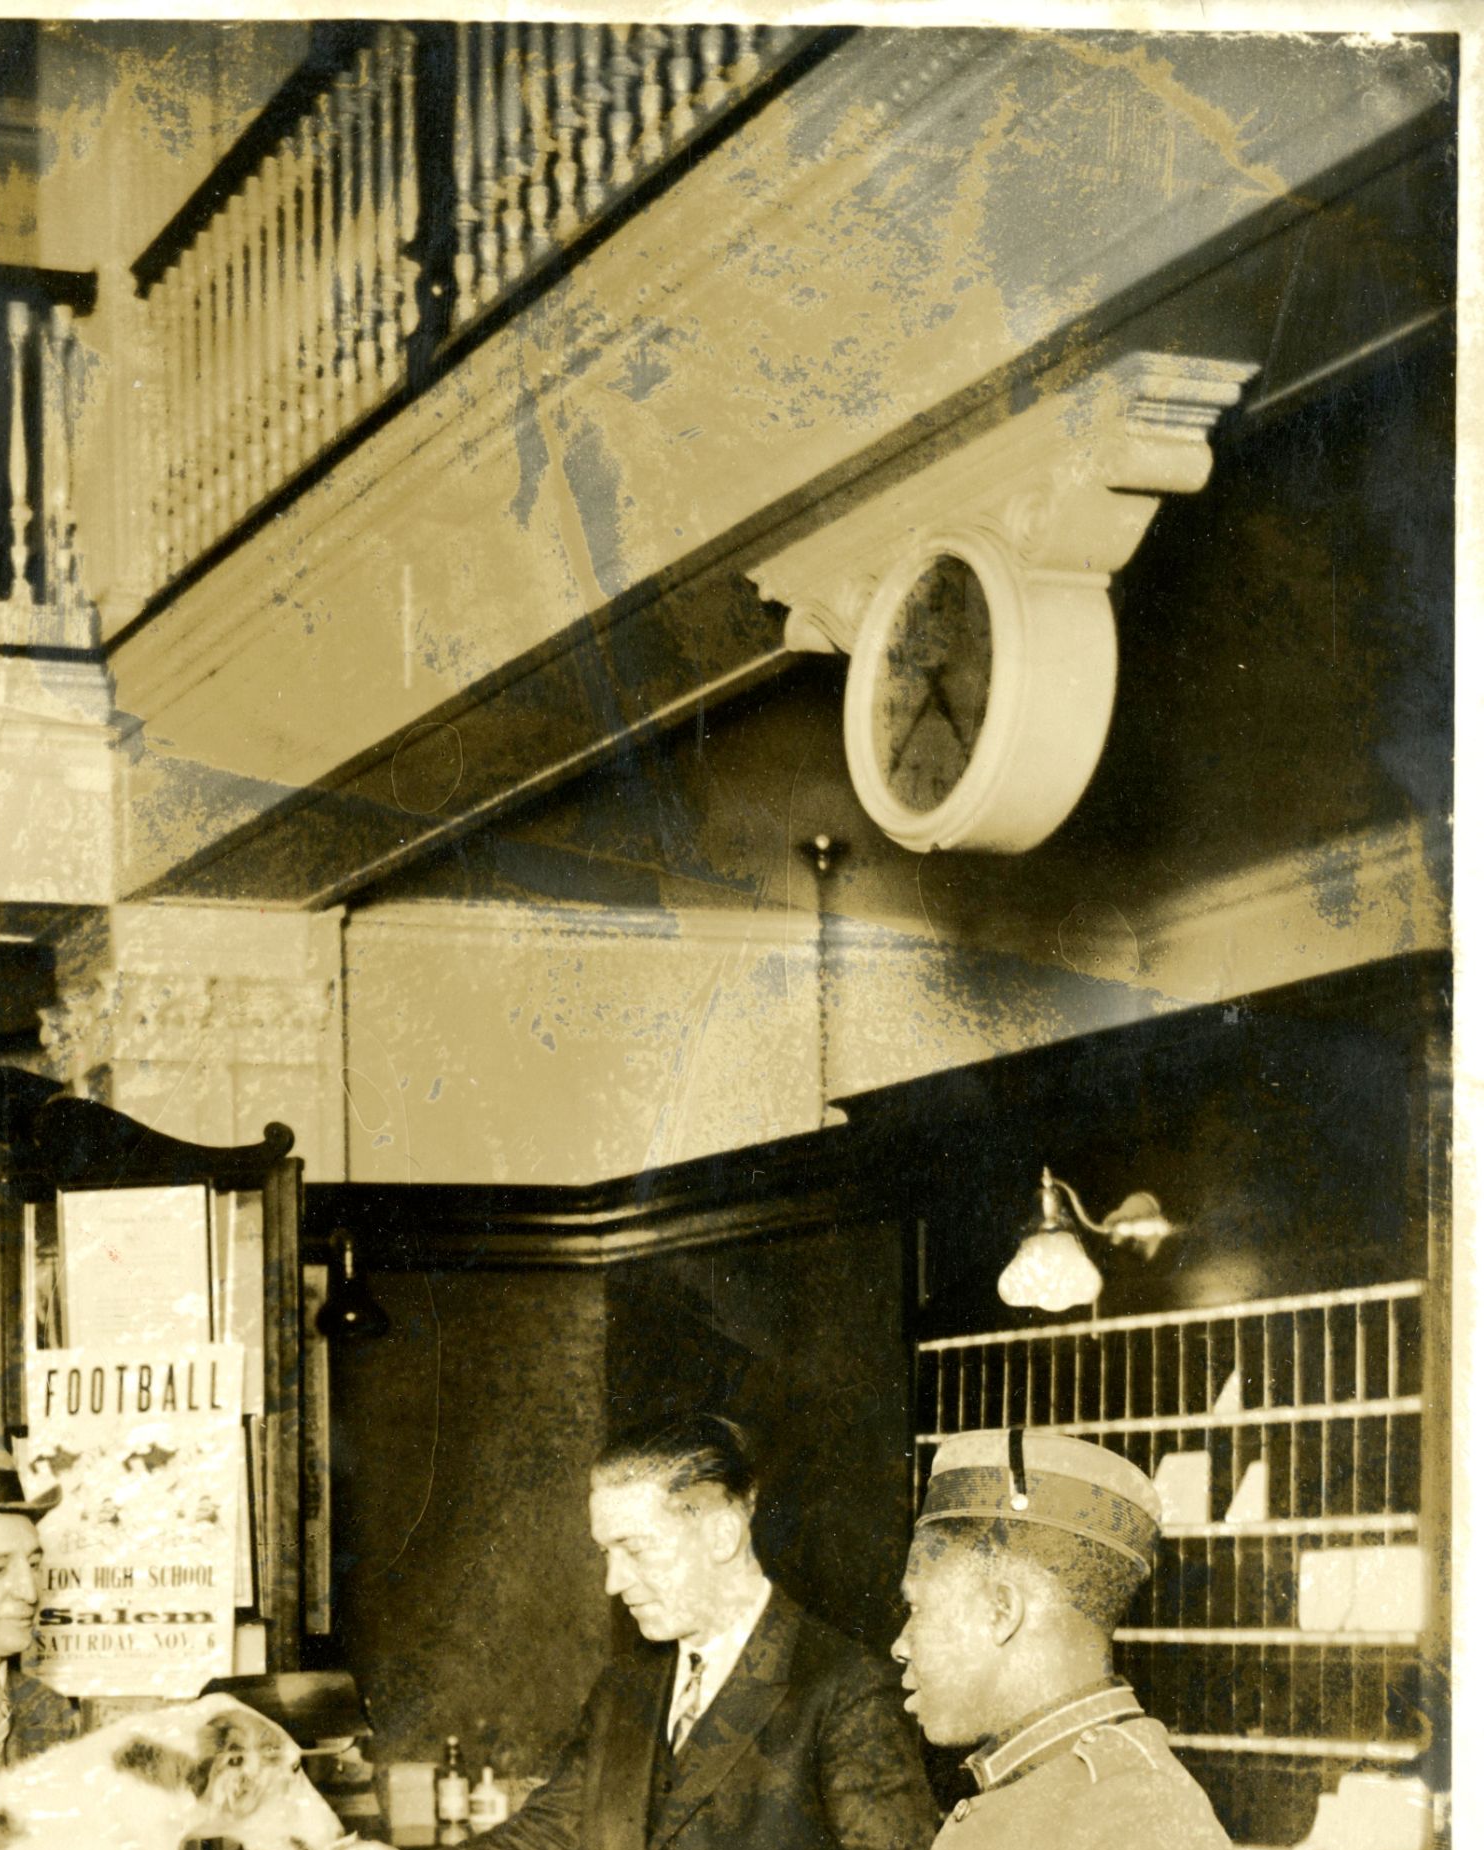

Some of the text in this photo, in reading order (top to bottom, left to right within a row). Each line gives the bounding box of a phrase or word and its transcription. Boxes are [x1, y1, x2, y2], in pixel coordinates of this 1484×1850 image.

[44, 1360, 222, 1417] FOOTBALL
[43, 1565, 215, 1591] EON HIGH SCHOOL
[38, 1607, 216, 1626] Salem
[206, 1632, 216, 1651] 6
